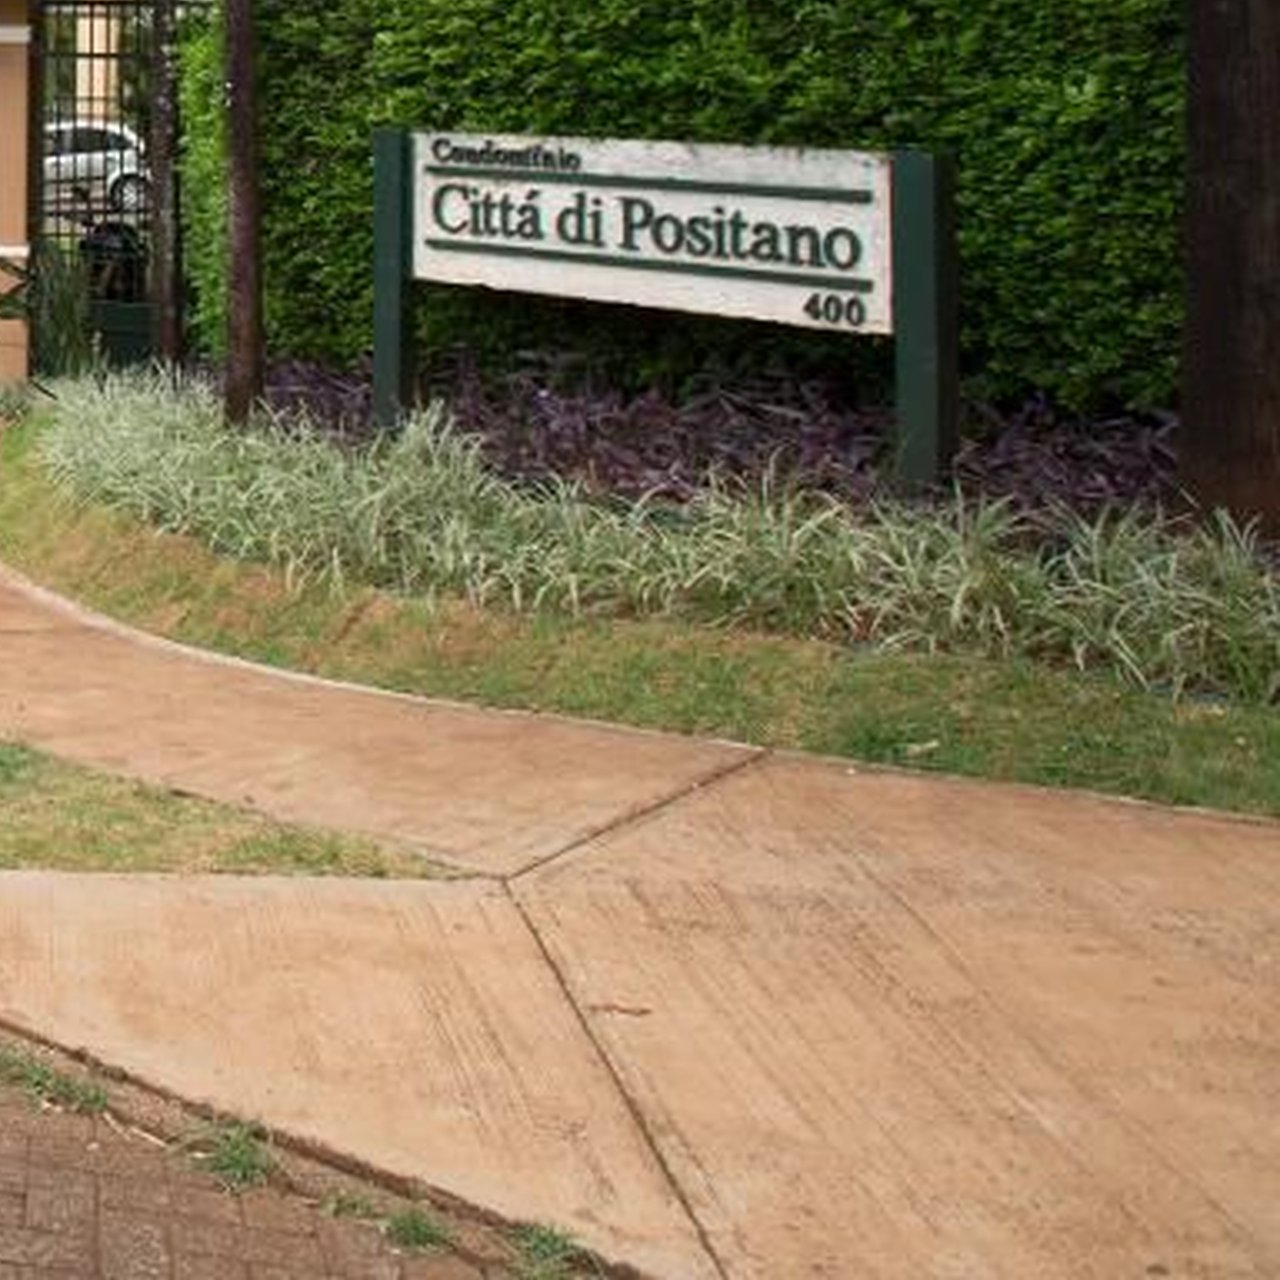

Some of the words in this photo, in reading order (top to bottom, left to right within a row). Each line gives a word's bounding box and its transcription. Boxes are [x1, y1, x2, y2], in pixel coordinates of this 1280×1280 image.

[432, 183, 543, 239] Cittá
[556, 191, 606, 246] di
[615, 195, 863, 270] Positano
[802, 292, 866, 326] 400
